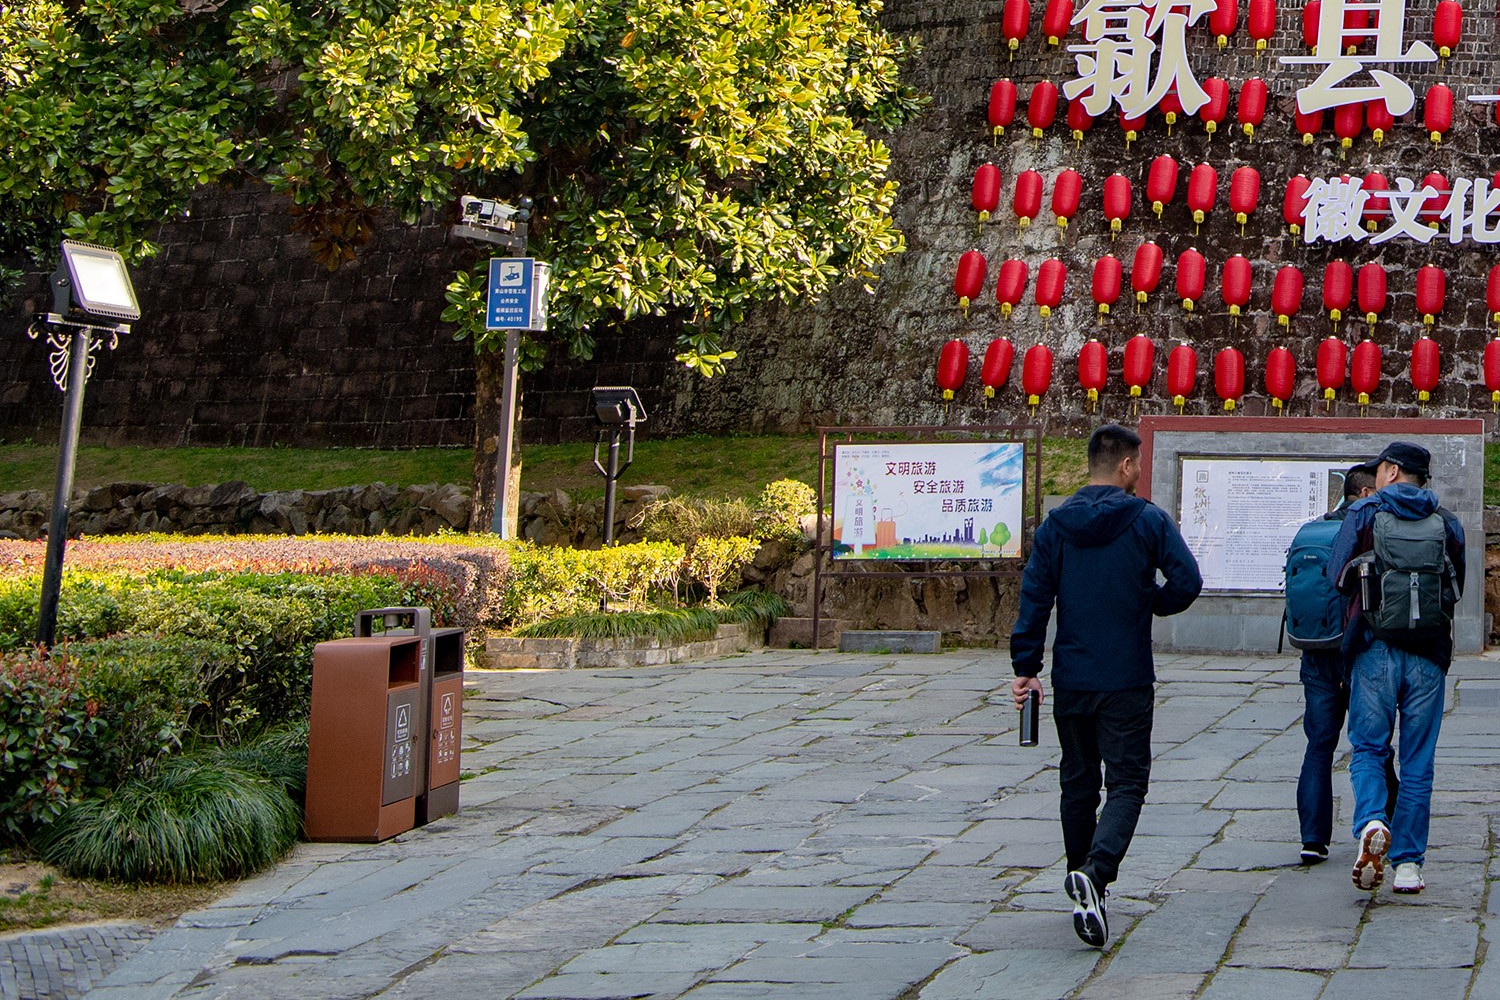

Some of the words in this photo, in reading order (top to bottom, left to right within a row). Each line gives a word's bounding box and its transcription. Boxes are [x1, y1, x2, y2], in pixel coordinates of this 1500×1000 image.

[885, 461, 937, 476] 文明旅游
[913, 480, 965, 494] 安全旅游
[941, 498, 993, 513] 品质旅游
[853, 499, 864, 538] 文明旅游
